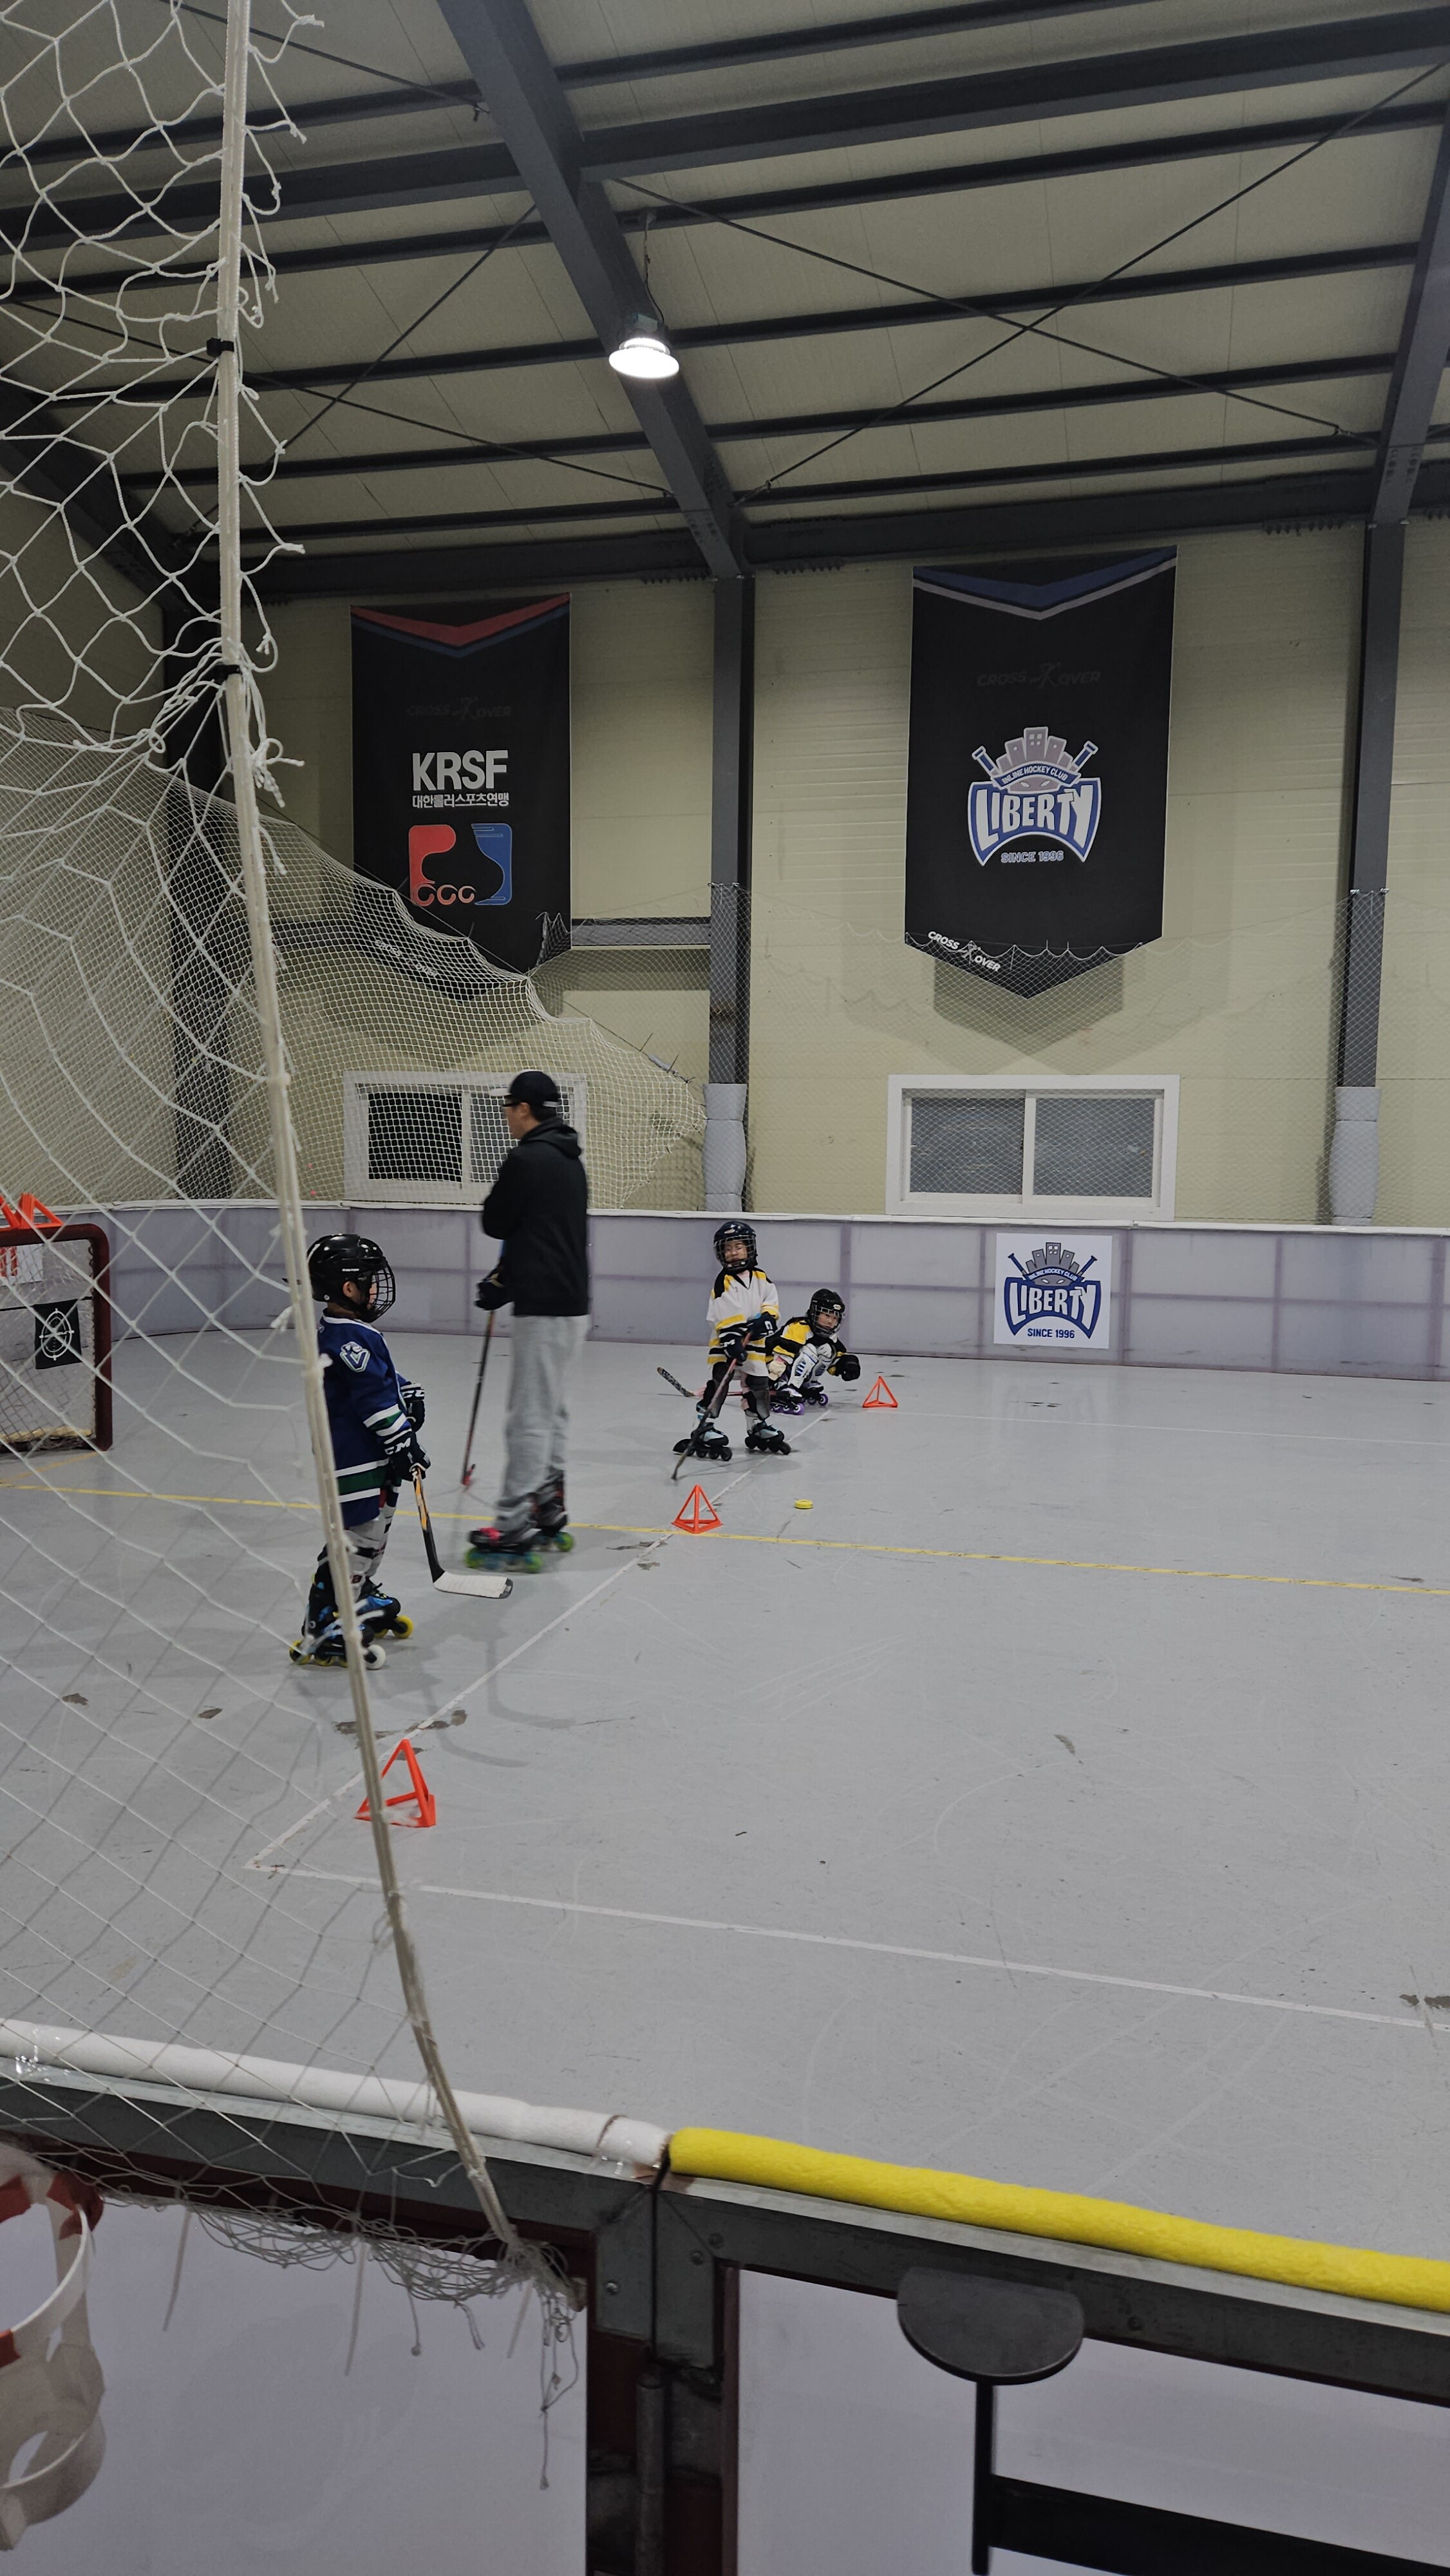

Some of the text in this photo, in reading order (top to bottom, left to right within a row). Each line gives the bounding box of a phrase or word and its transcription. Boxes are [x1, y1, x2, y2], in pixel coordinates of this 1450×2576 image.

[412, 750, 509, 791] KRSF
[1001, 765, 1068, 784] INLINE HOCKEY CLUB
[412, 792, 509, 809] 대한롤러스포츠연맹
[975, 784, 1094, 851] LIBERTY
[1001, 850, 1064, 864] SINCE 1996
[928, 931, 1001, 972] CROSS OVER
[1009, 1282, 1097, 1330] LIBERTY
[1028, 1328, 1075, 1339] SINCE 1996
